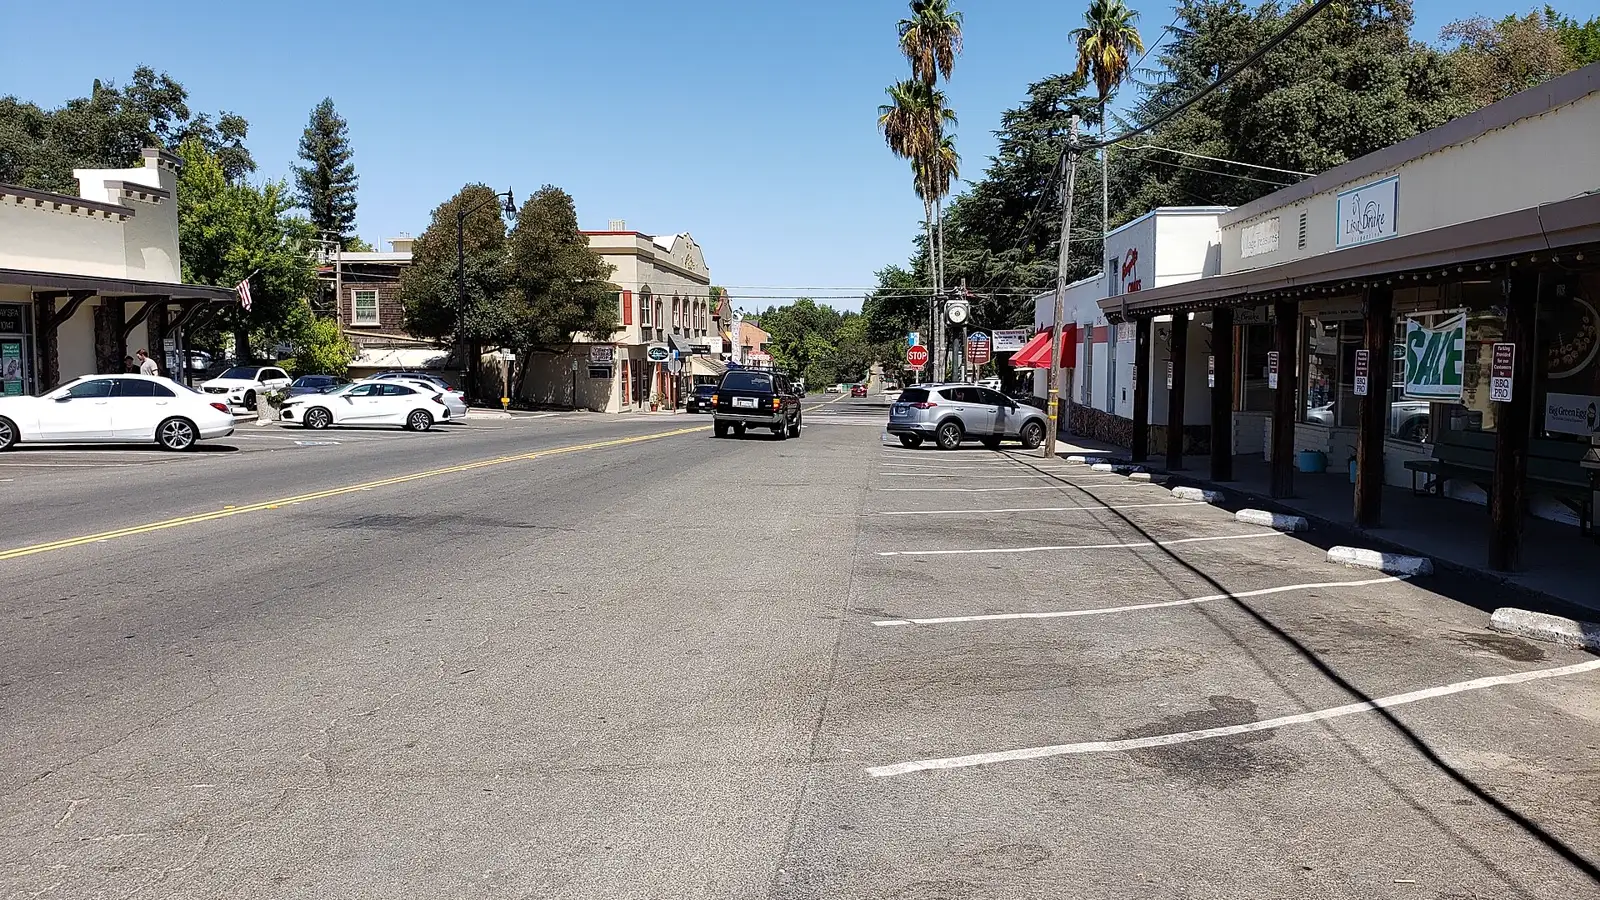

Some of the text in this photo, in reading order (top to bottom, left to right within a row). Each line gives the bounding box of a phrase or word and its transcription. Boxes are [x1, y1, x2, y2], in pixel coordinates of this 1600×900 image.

[1362, 203, 1386, 233] Drake
[908, 351, 927, 360] STOP
[1406, 326, 1463, 385] SALE
[1494, 379, 1509, 388] BBQ
[1494, 388, 1508, 398] PRO
[1548, 405, 1558, 417] Big
[1558, 406, 1575, 417] Green
[1575, 407, 1587, 420] Egg
